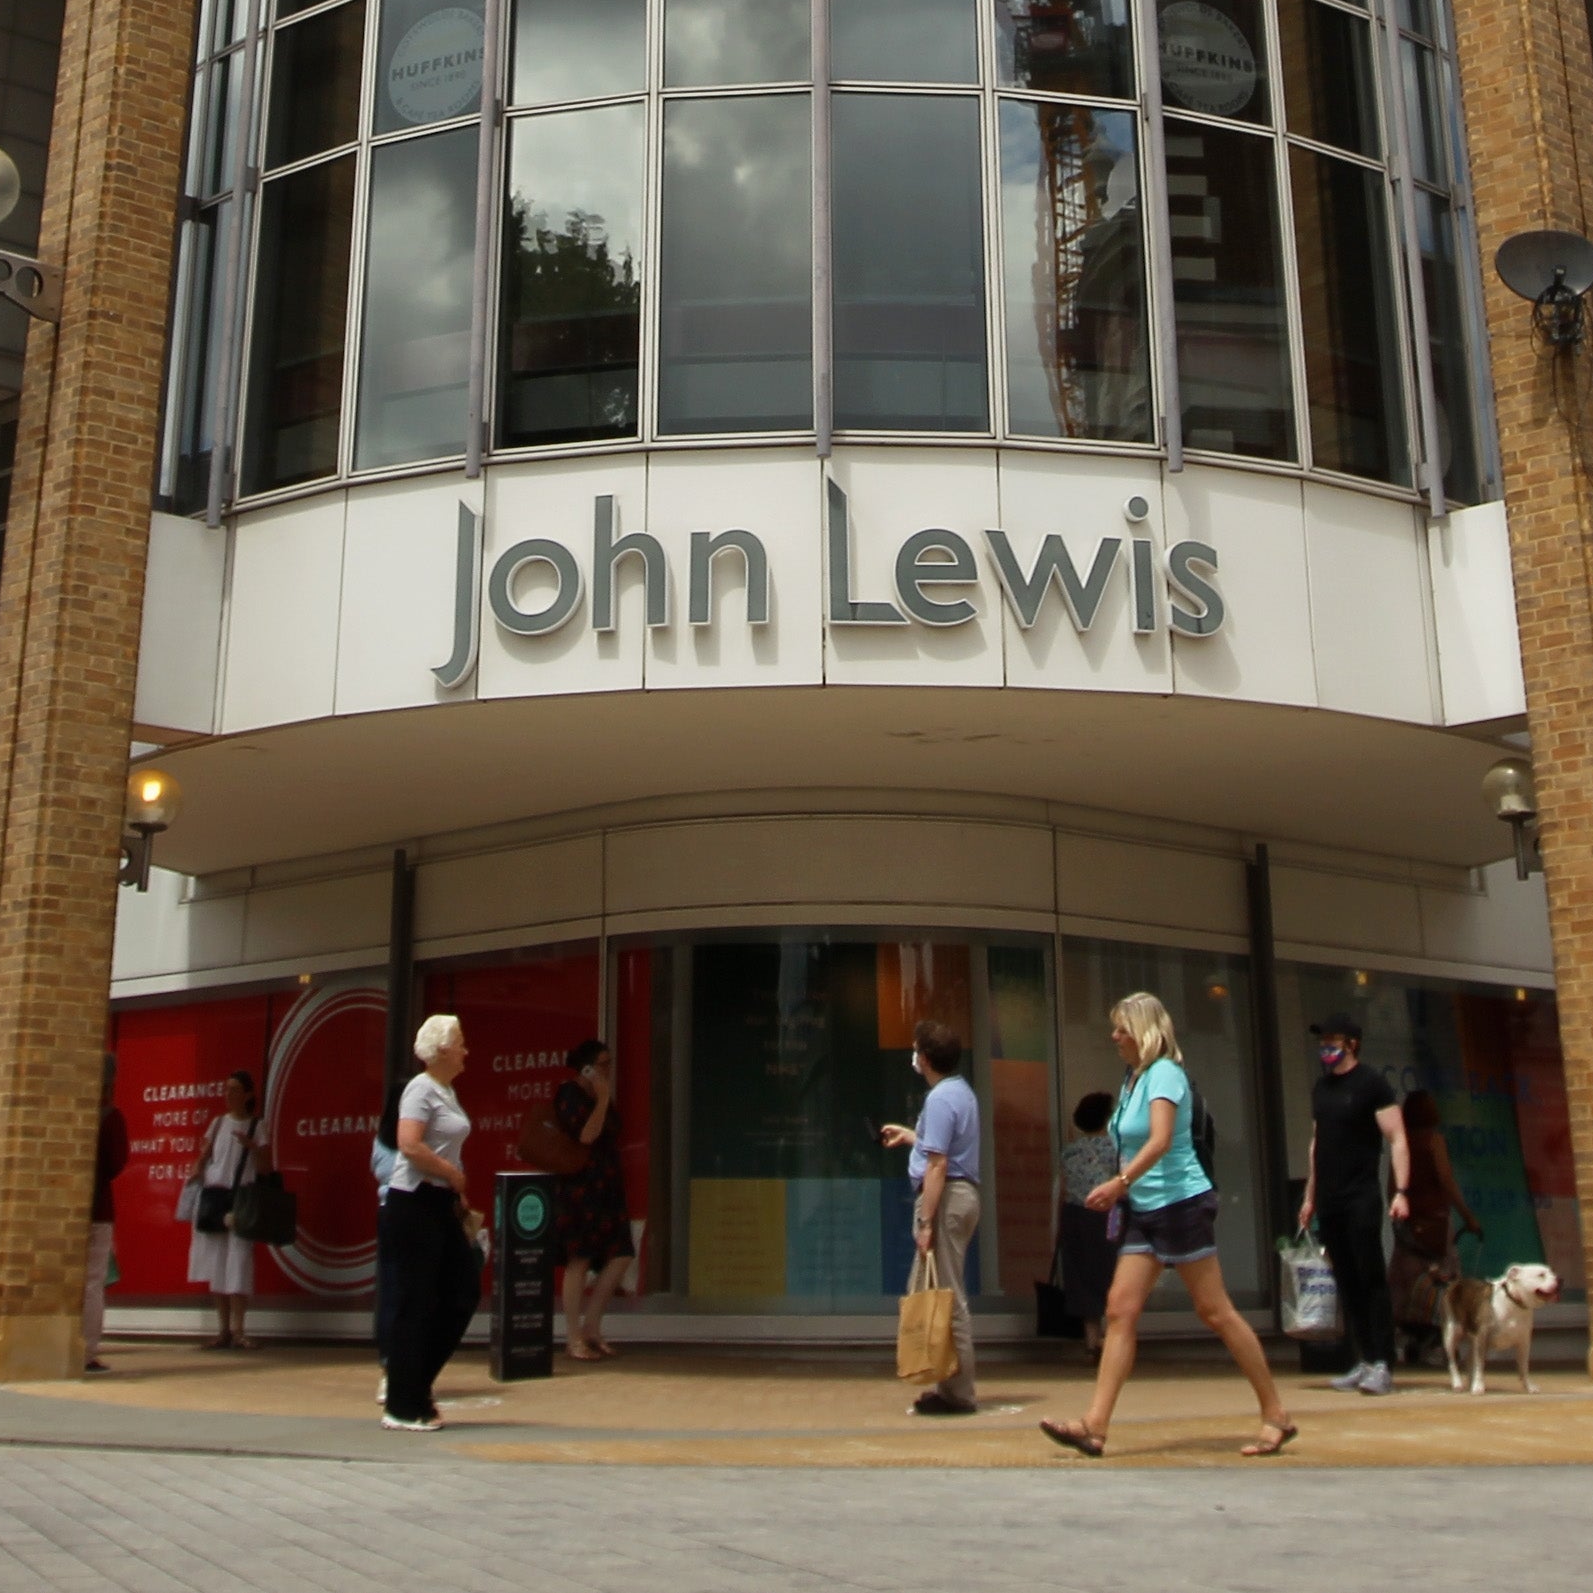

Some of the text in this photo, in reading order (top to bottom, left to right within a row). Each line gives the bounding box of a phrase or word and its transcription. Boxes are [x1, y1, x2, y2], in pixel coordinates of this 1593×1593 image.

[430, 474, 1228, 690] John Lewis
[143, 1082, 225, 1102] CLEARANCE
[507, 1082, 552, 1100] MORE
[152, 1110, 188, 1127] MORE
[478, 1113, 523, 1131] WHAT
[130, 1137, 195, 1153] WHAT YOU
[148, 1164, 174, 1180] FOR
